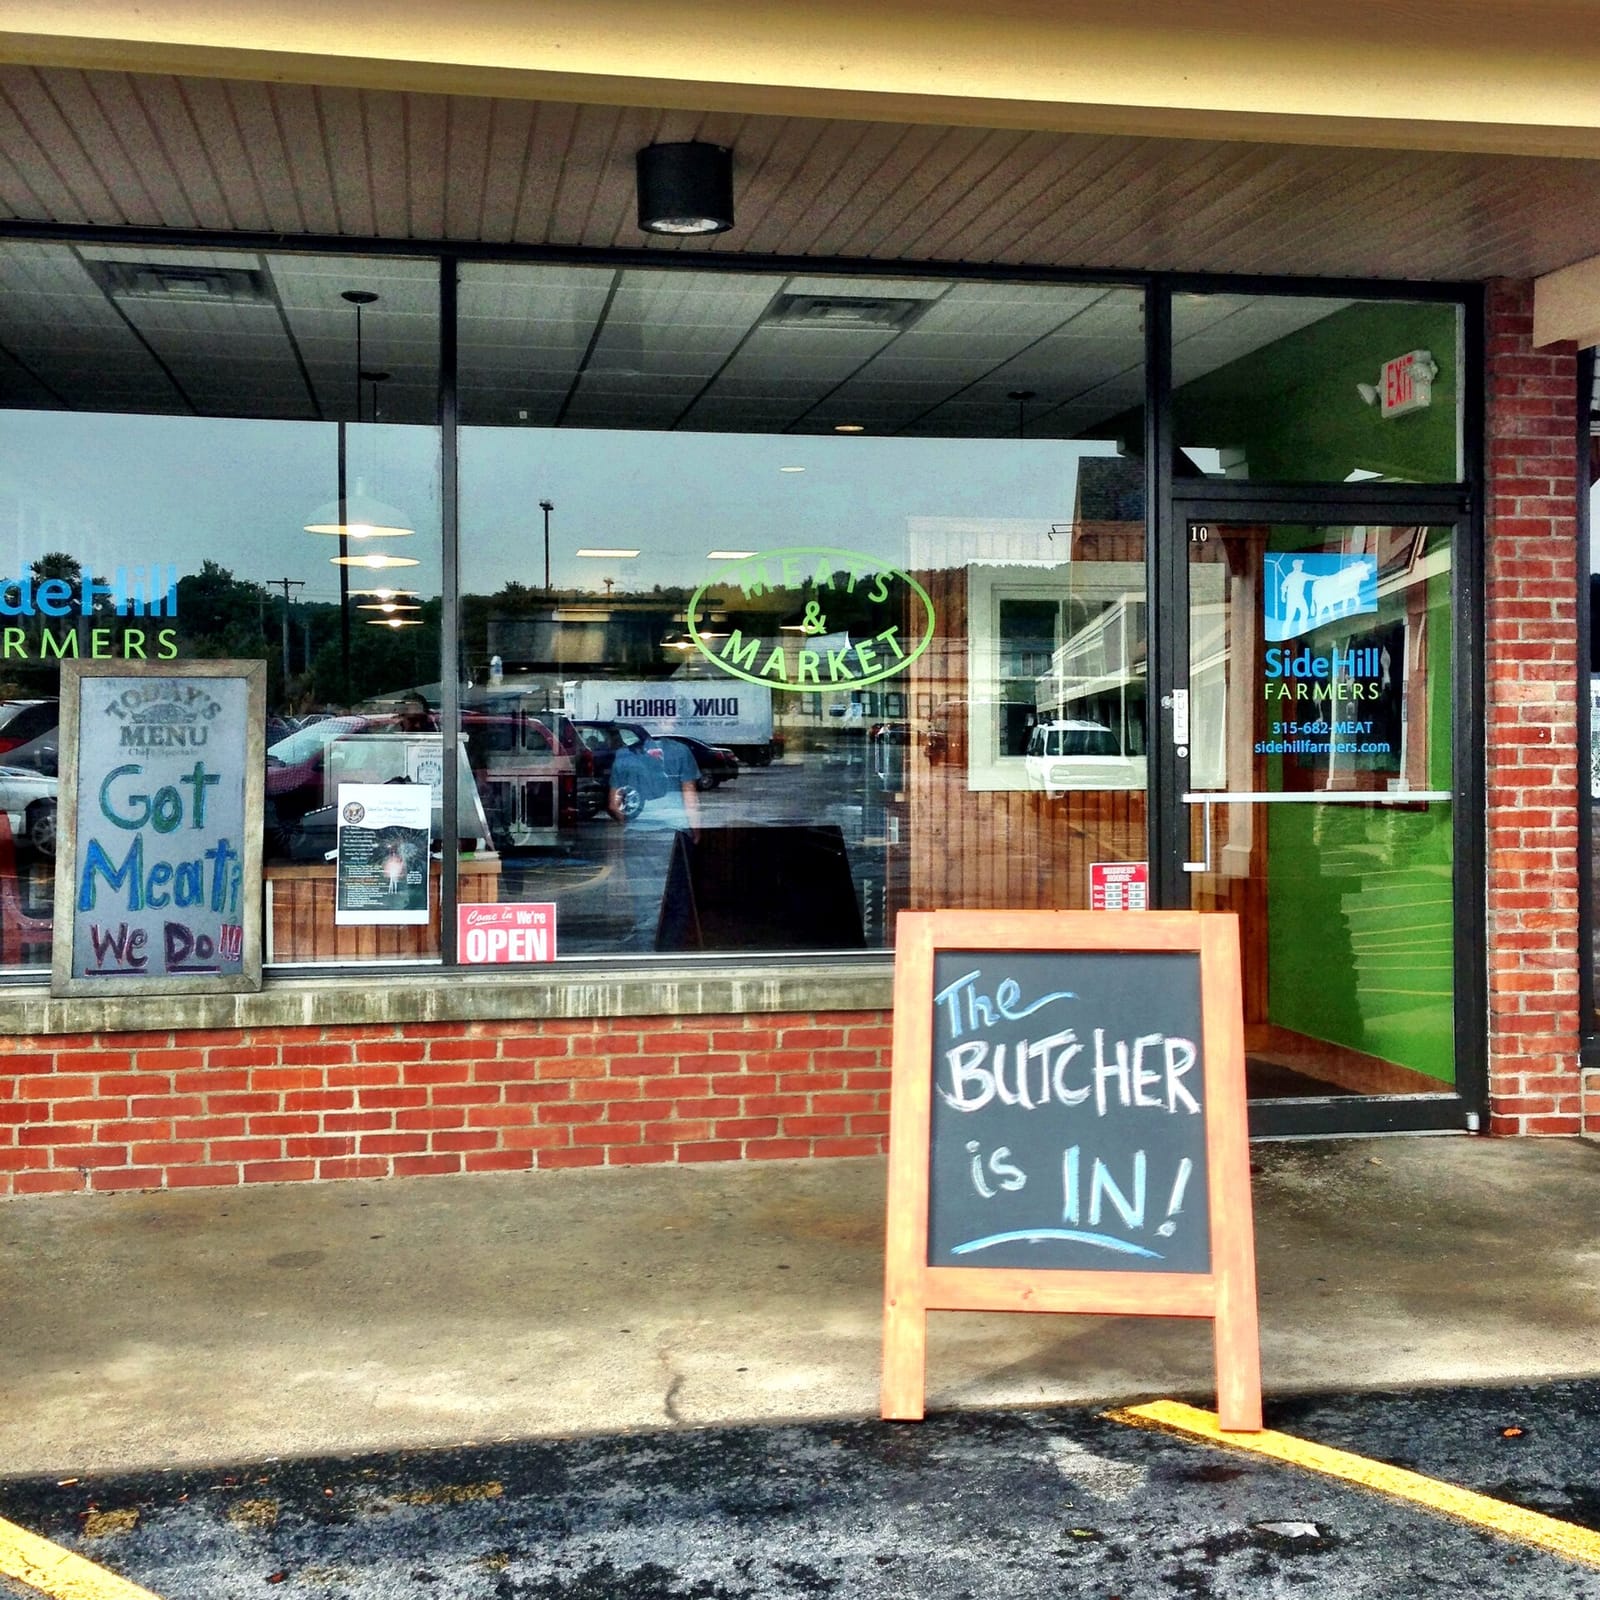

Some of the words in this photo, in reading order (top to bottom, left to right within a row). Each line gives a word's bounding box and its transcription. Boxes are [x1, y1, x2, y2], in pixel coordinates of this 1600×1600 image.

[1387, 355, 1415, 408] EXIT
[1191, 526, 1208, 542] 10
[738, 556, 896, 603] MEATS
[802, 600, 827, 635] &
[3, 626, 179, 660] RMERS
[720, 624, 905, 684] MARKET
[1264, 682, 1379, 701] FARMERS
[119, 725, 208, 747] MENU
[1272, 721, 1374, 735] 315-682-MEAT
[1254, 739, 1391, 754] sidehillfarmers.com
[99, 761, 221, 834] Got
[467, 910, 498, 925] Come
[501, 906, 513, 920] in
[516, 911, 546, 925] We're
[90, 921, 149, 968] We
[466, 928, 547, 963] OPEN
[934, 969, 1080, 1039] The
[936, 1028, 1202, 1117] BUTCHER
[965, 1139, 1028, 1198] is
[1062, 1143, 1193, 1237] IN!
